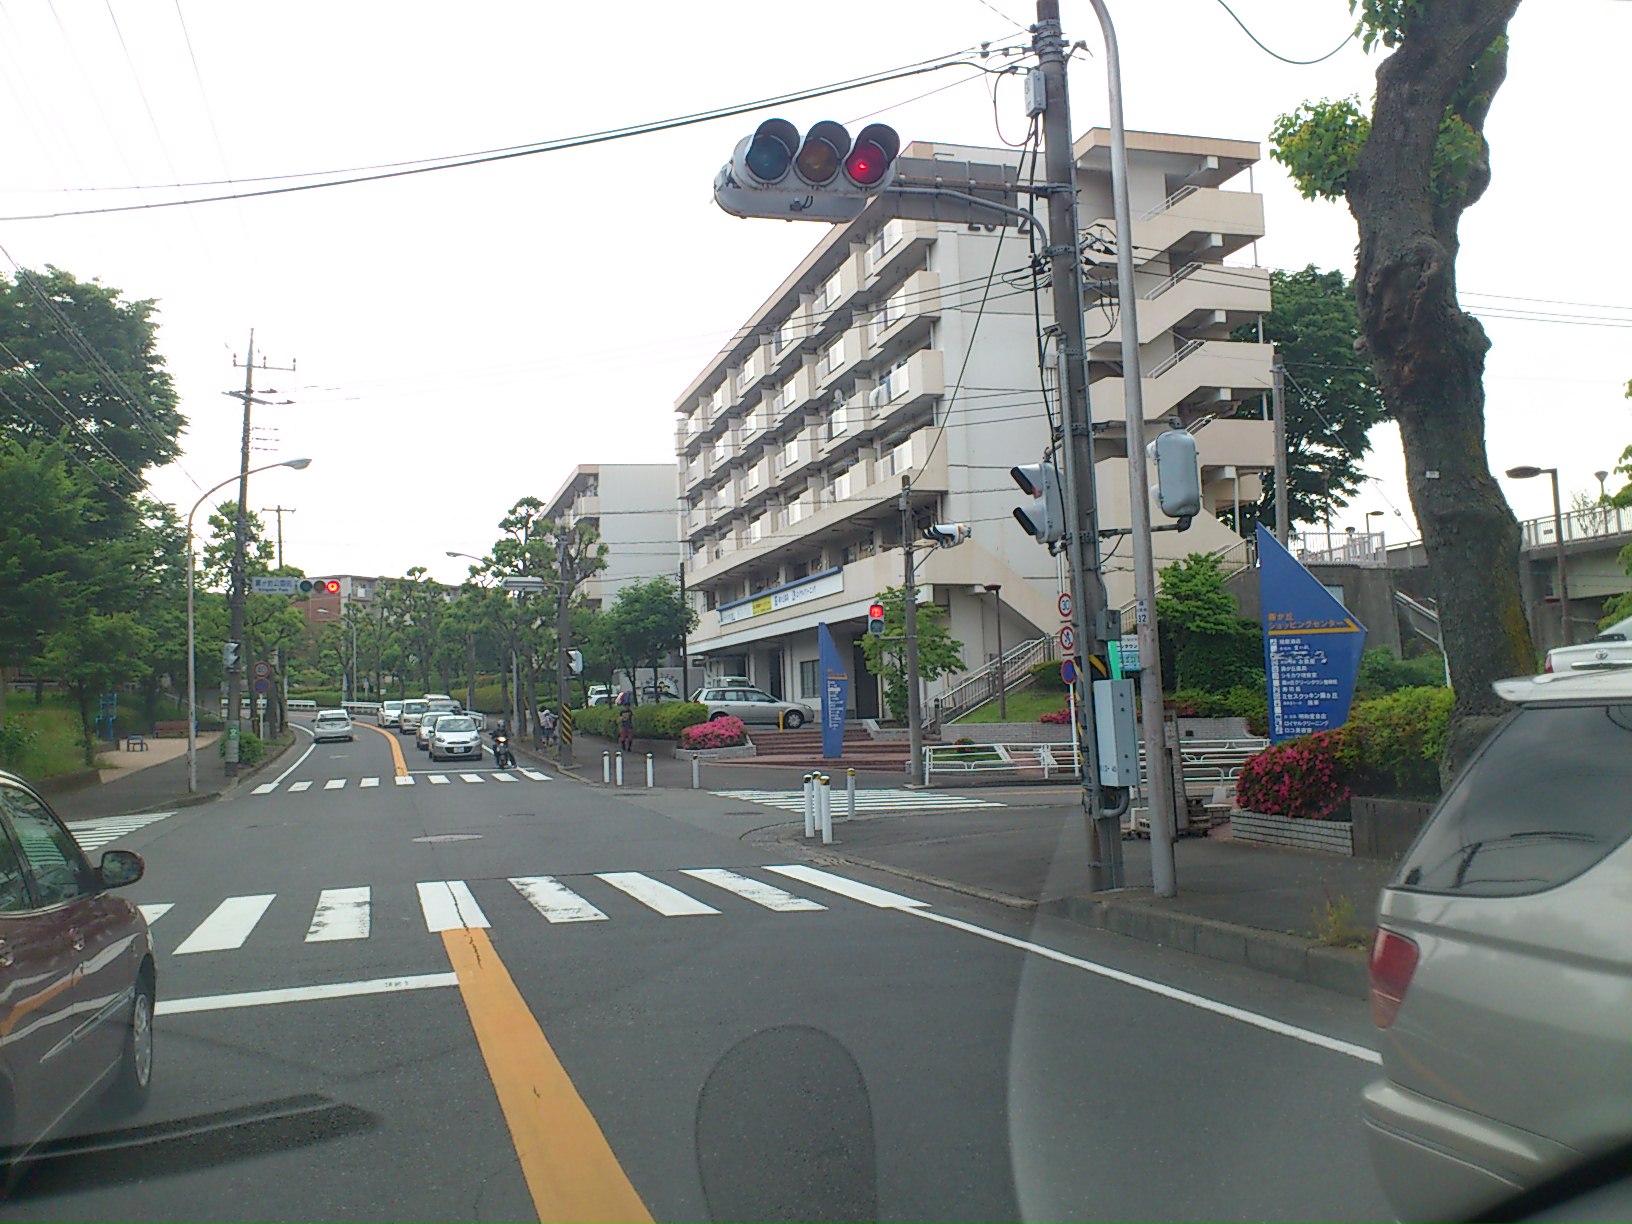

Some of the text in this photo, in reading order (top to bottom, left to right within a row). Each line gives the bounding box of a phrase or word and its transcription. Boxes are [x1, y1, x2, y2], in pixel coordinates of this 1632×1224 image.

[1061, 599, 1071, 611] 30
[1268, 619, 1344, 630] ショッピングセンター
